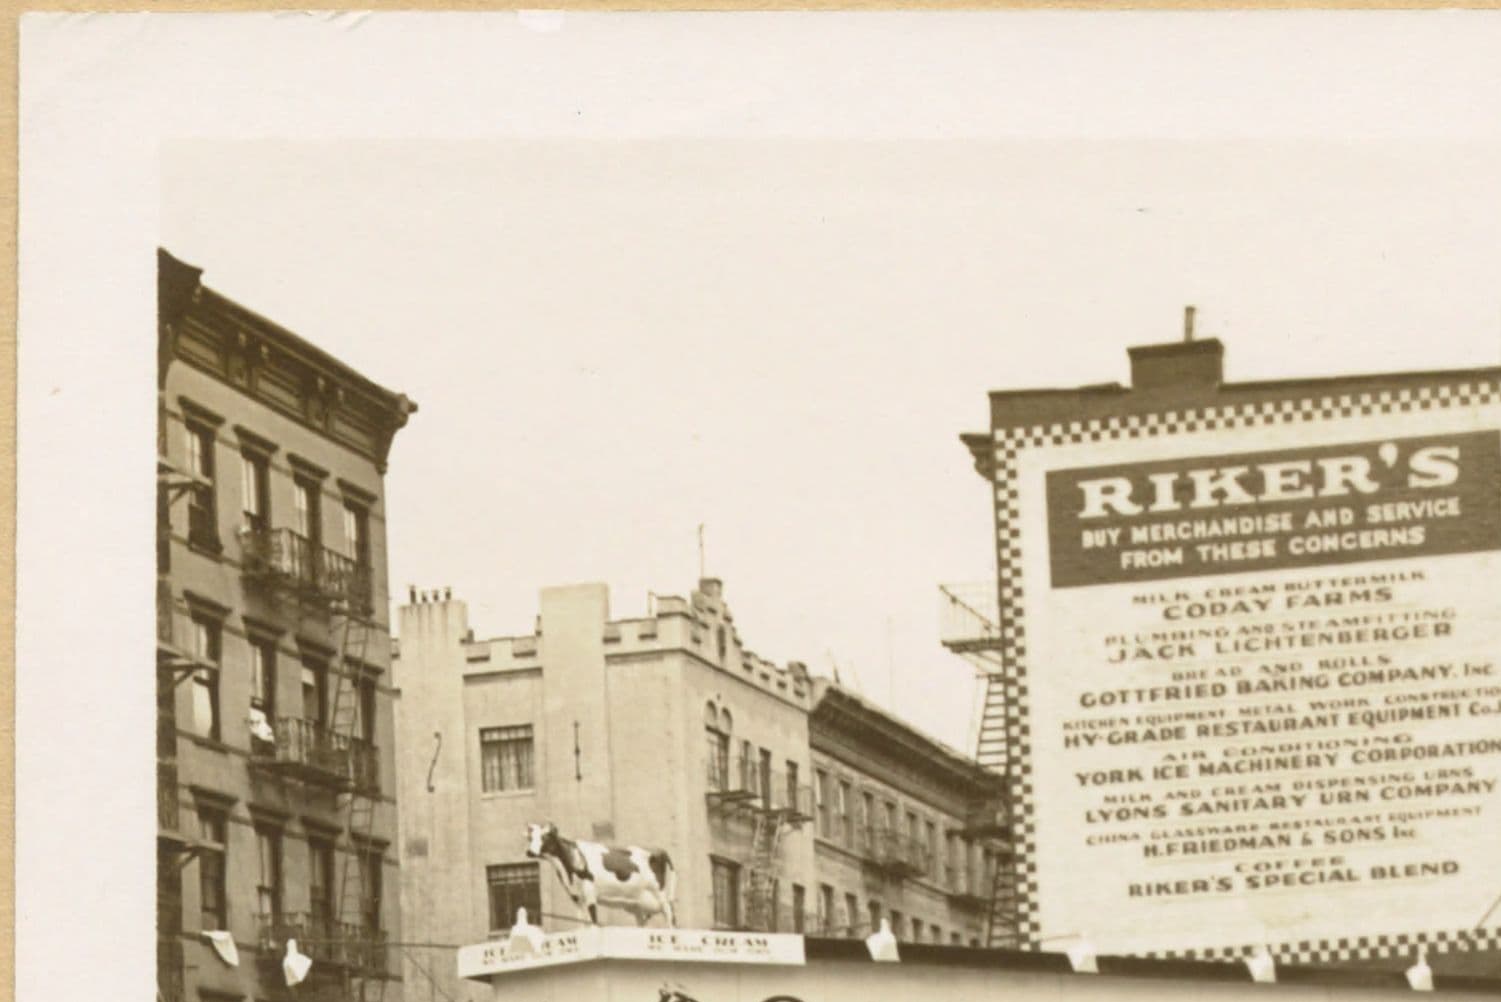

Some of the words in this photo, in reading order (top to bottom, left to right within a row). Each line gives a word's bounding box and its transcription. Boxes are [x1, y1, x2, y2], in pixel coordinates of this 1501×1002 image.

[1077, 443, 1460, 518] RIKER'S
[1082, 528, 1121, 549] BUY
[1131, 512, 1292, 545] MERCHANDISE
[1304, 507, 1354, 529] AND
[1366, 497, 1461, 524] SERVICE
[1121, 547, 1183, 569] FROM
[1196, 539, 1276, 563] THESE
[1289, 526, 1426, 555] CONCERNS
[1132, 591, 1190, 604] MILK
[1205, 584, 1276, 599] CREAM
[1284, 570, 1425, 592] BUTTERMILK
[1163, 598, 1271, 620] CODAY
[1286, 586, 1393, 609] FARMS
[1105, 625, 1229, 647] PLUMBING
[1239, 622, 1274, 635] AND
[1282, 607, 1456, 631] STEAMFITTING
[1108, 643, 1195, 663] JACK
[1216, 622, 1452, 654] LICHTENBERGER
[1172, 665, 1242, 682] BREAD
[1259, 661, 1302, 676] AND
[1319, 654, 1391, 670] ROLLS
[1080, 683, 1227, 708] GOTTFRIED
[1237, 674, 1329, 696] BAKING
[1063, 716, 1129, 731] KITCHEN
[1137, 708, 1226, 727] EQUIPMENT
[1239, 703, 1296, 717] METAL
[1310, 698, 1370, 712] WORK
[1197, 713, 1339, 738] RESTAURANT
[1349, 702, 1460, 729] EQUIPMENT
[1163, 751, 1206, 762] AIR
[1223, 733, 1413, 758] CONDITIONING
[1076, 768, 1143, 788] YORK
[1154, 763, 1190, 781] ICE
[1199, 753, 1338, 777] MACHINERY
[1104, 793, 1152, 804] MILK
[1165, 788, 1201, 800] AND
[1211, 783, 1282, 798] CREAM
[1293, 772, 1415, 791] DISPENSING
[1424, 766, 1474, 780] URNS
[1086, 803, 1168, 824] LYONS
[1180, 793, 1306, 817] SANITARY
[1320, 789, 1370, 806] URN
[1380, 777, 1497, 801] COMPANY
[1086, 832, 1140, 846] CHINA
[1150, 823, 1259, 841] GLASSWARE
[1269, 813, 1381, 831] RESTAURANT
[1388, 805, 1482, 824] EQUIPMENT
[1301, 834, 1313, 847] &
[1324, 826, 1386, 845] SONS
[1129, 876, 1233, 898] RIKER'S
[1245, 868, 1360, 890] SPECIAL
[1371, 860, 1460, 880] BLEND
[1234, 855, 1345, 873] COFFEE
